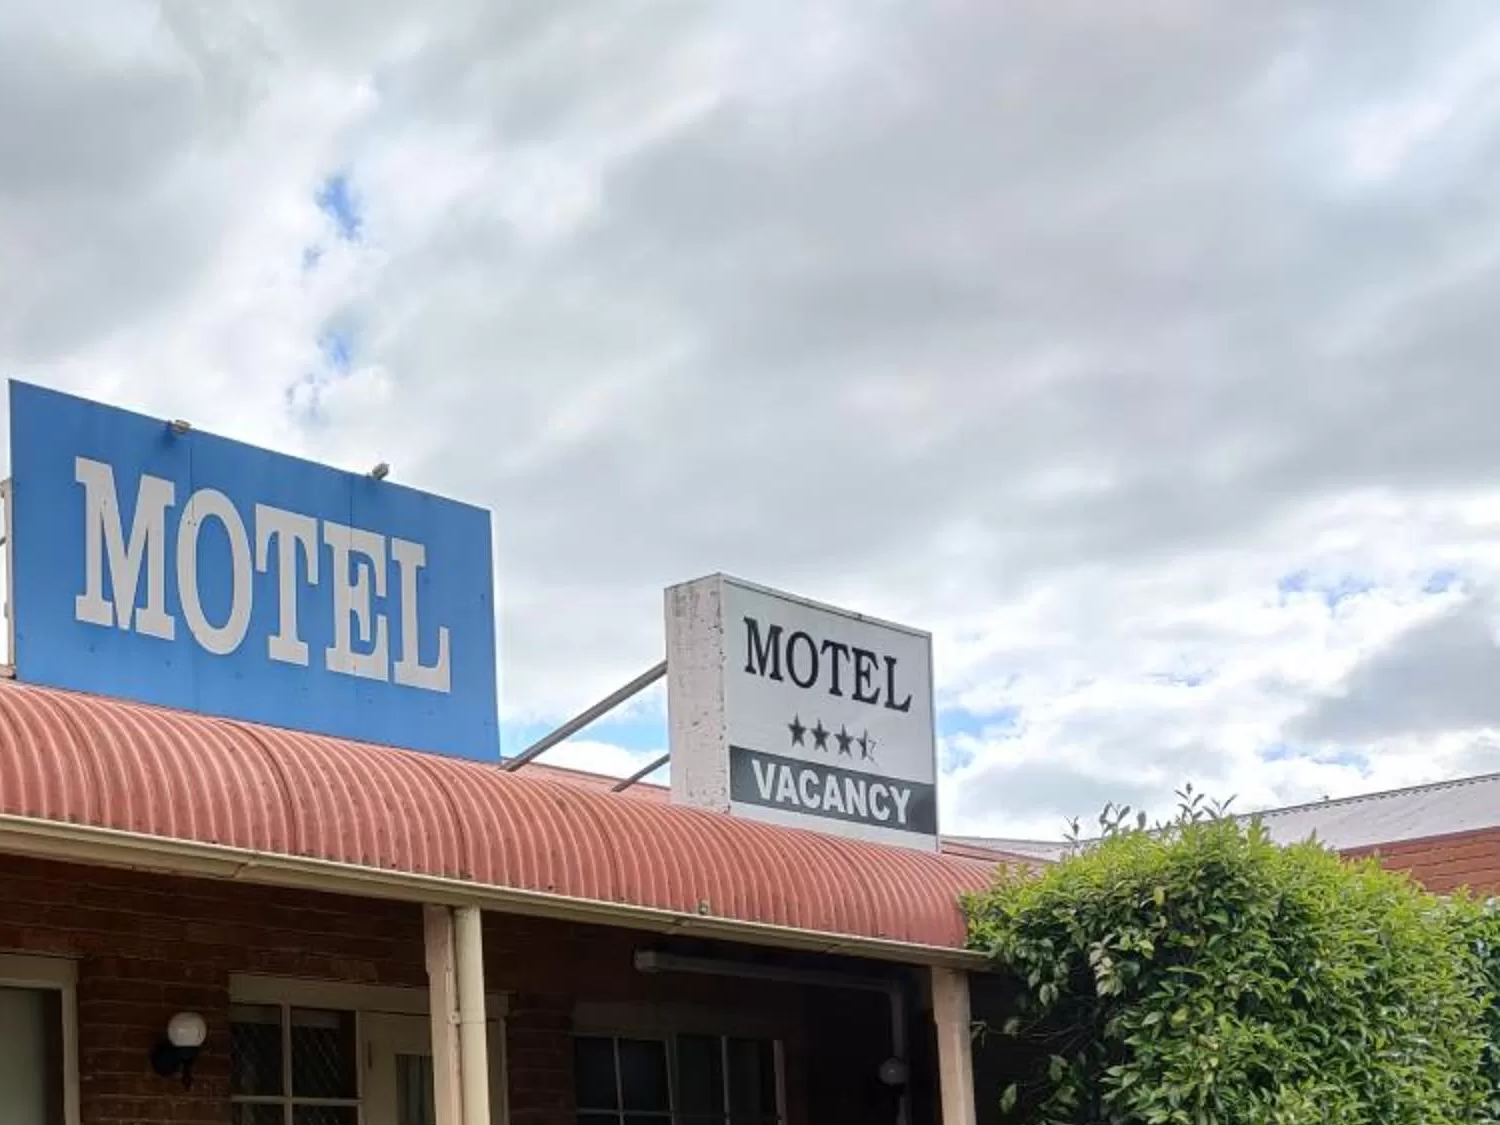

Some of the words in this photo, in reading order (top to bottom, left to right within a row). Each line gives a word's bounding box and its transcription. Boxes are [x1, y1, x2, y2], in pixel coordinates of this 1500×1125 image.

[75, 455, 451, 693] MOTEL
[743, 615, 913, 713] MOTEL
[751, 759, 912, 824] VACANCY
